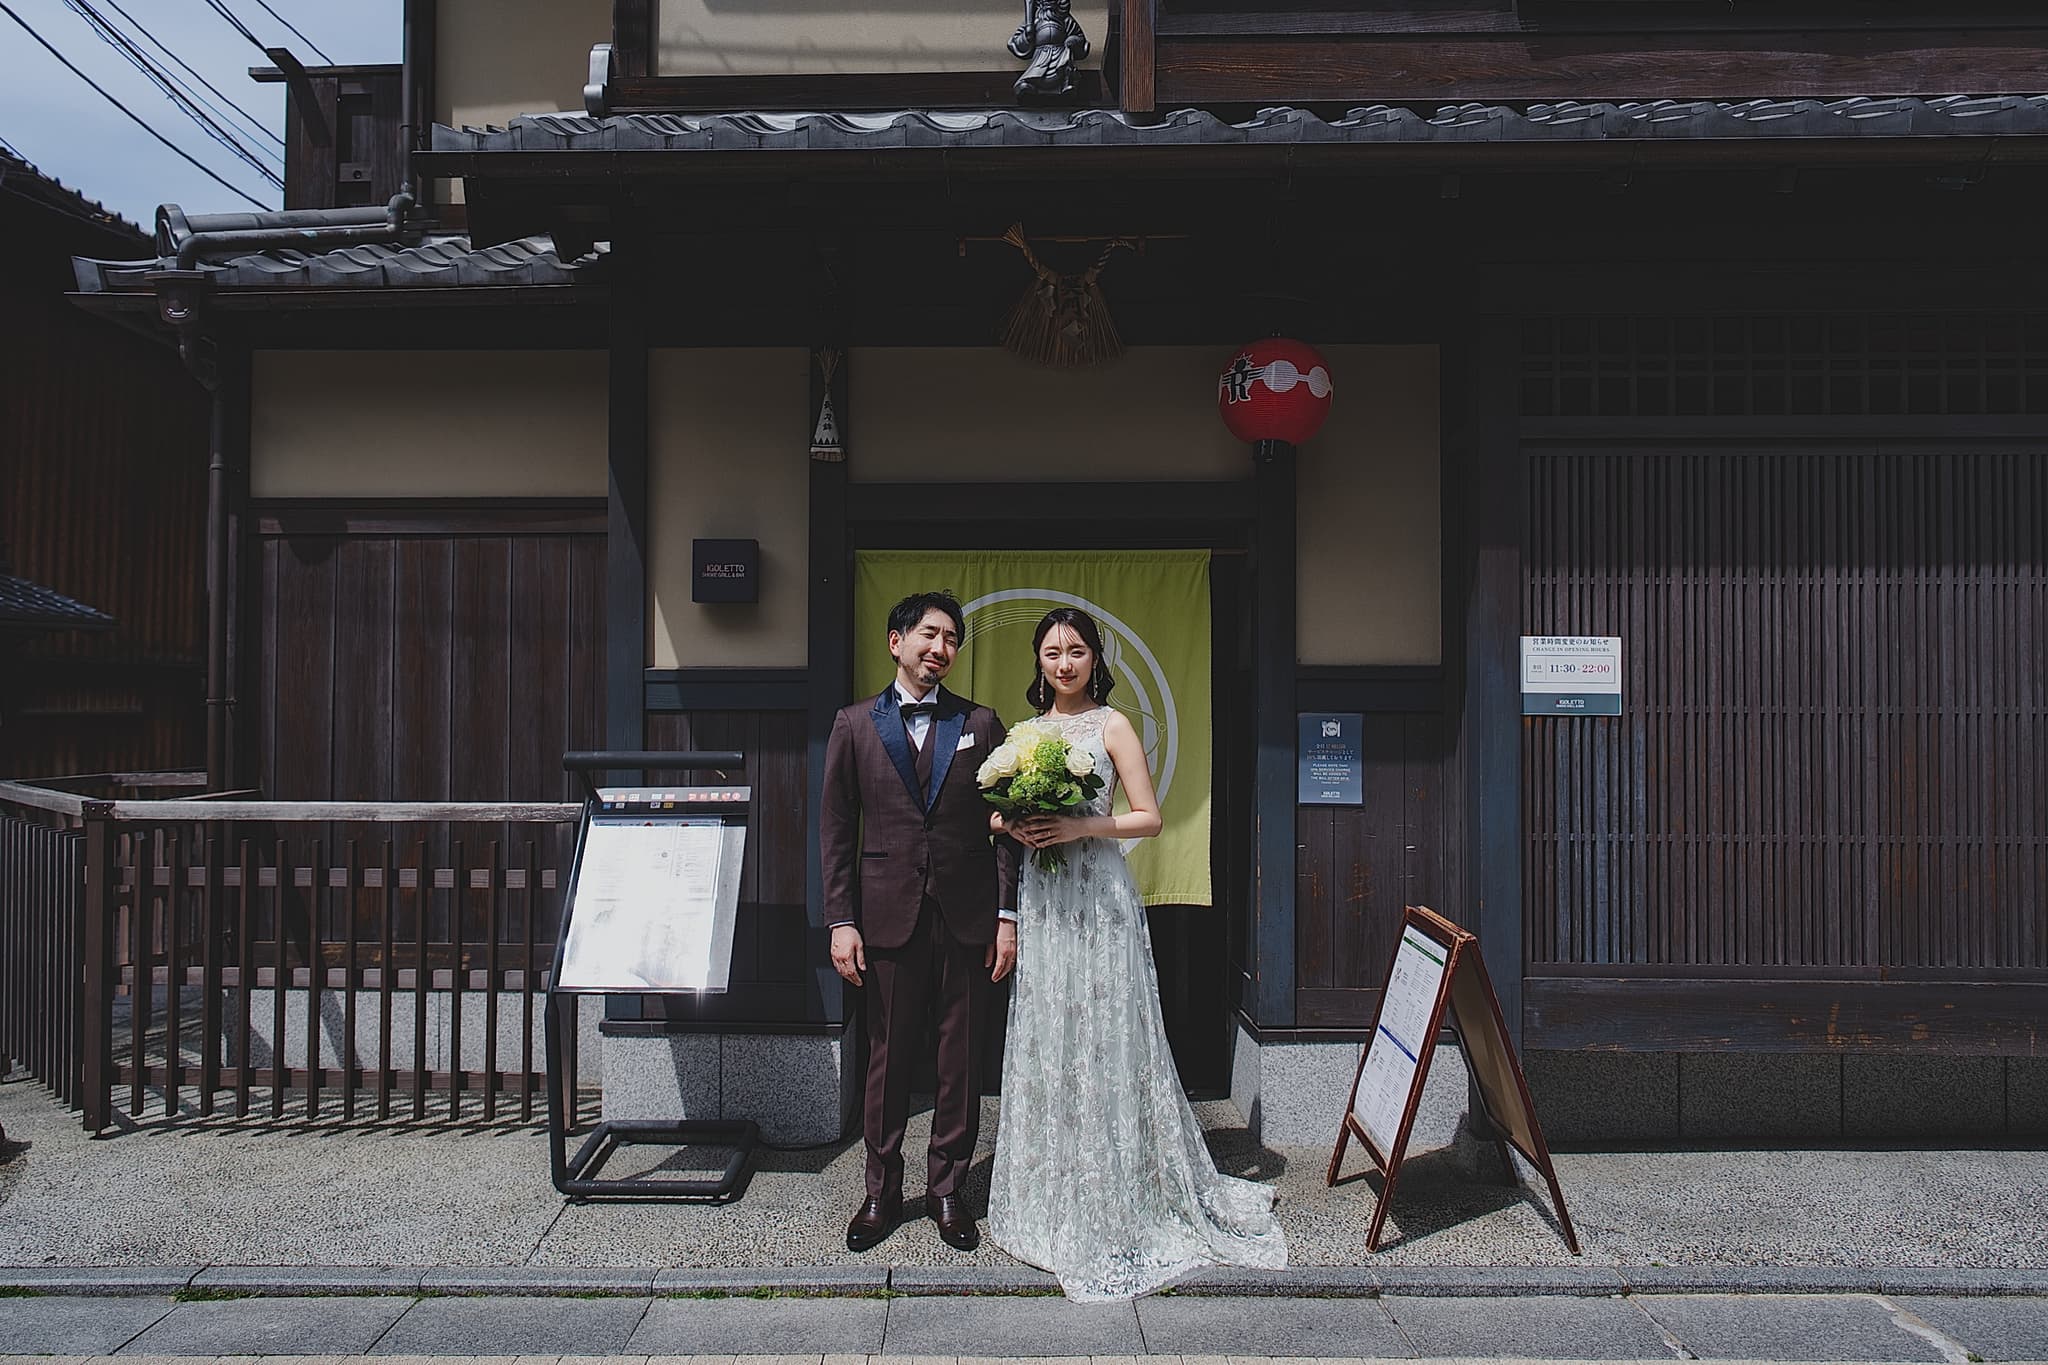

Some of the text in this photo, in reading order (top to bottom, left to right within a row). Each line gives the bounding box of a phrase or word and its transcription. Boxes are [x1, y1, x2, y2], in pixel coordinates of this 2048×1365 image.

[1532, 638, 1609, 646] 営業時間変更のお知らせ
[1550, 664, 1576, 673] 11:30
[1582, 664, 1610, 673] 22:00
